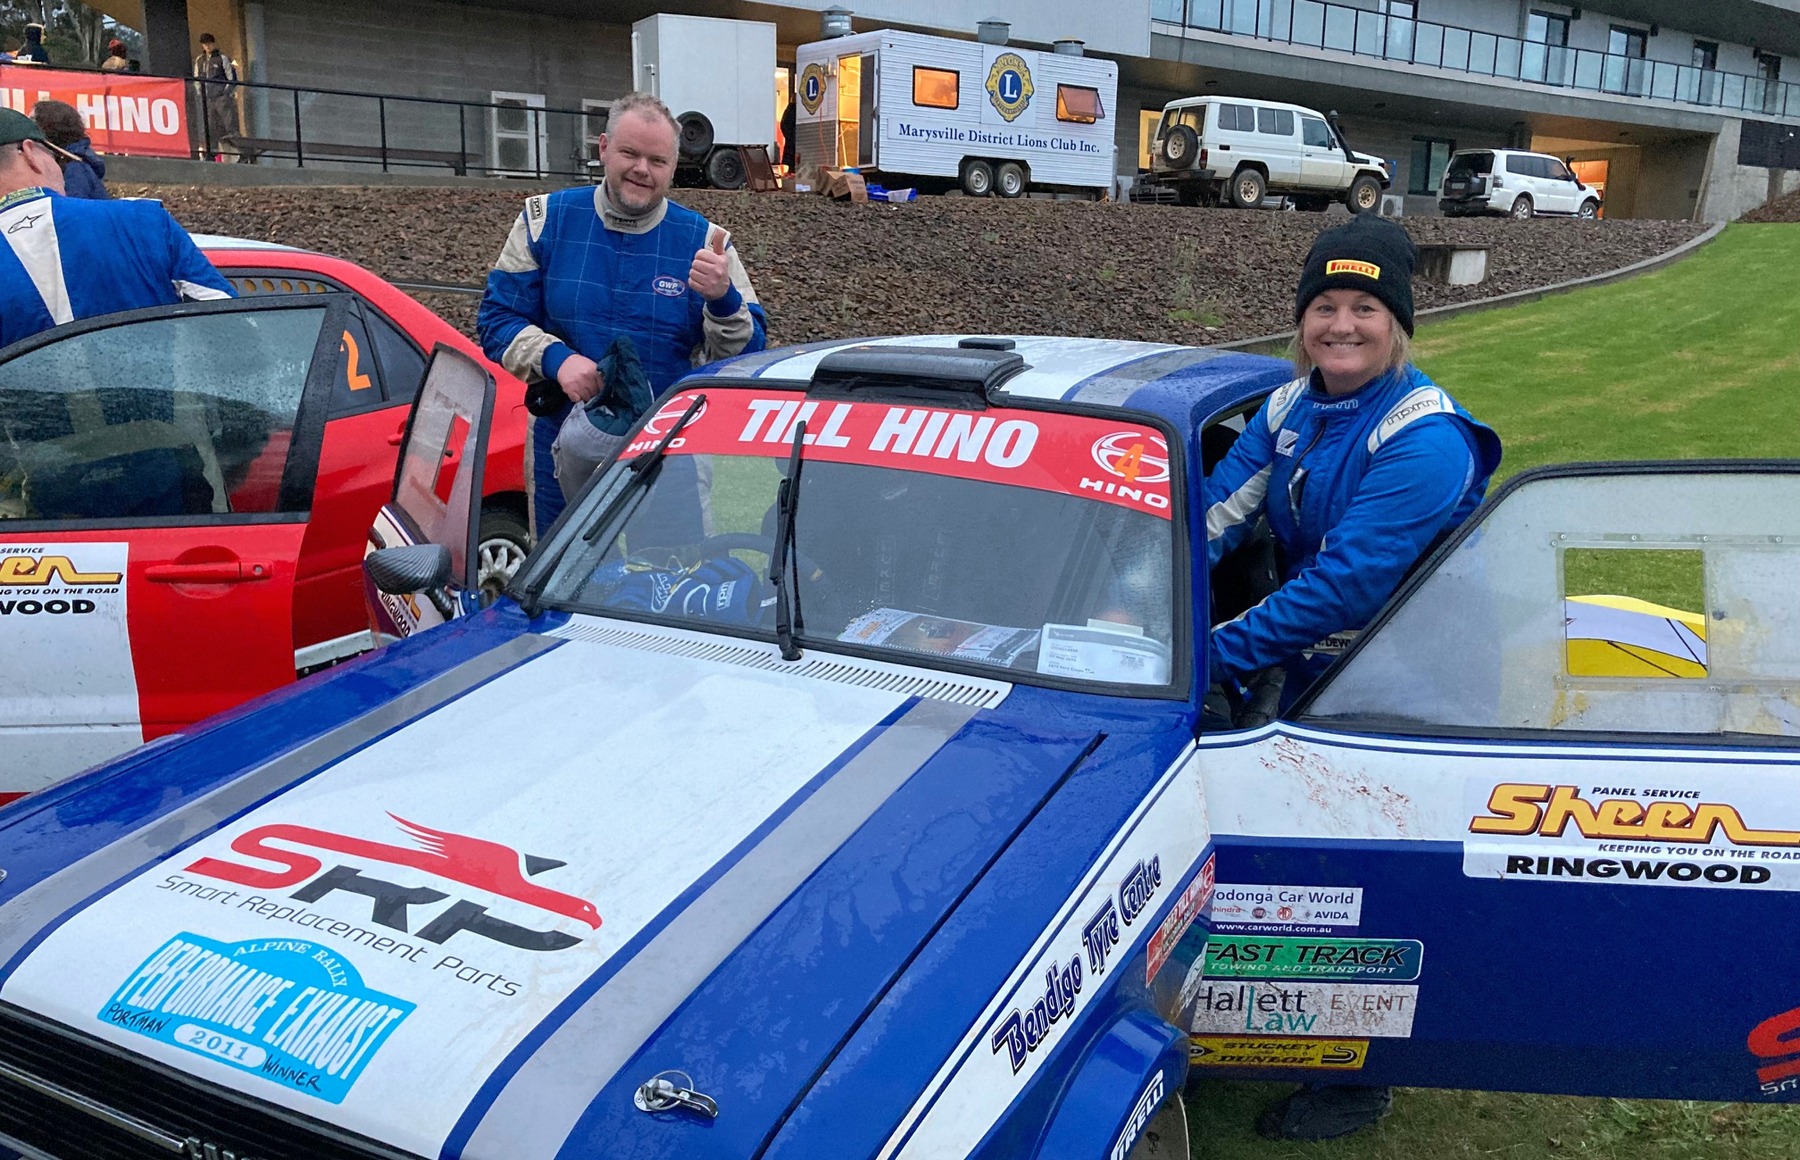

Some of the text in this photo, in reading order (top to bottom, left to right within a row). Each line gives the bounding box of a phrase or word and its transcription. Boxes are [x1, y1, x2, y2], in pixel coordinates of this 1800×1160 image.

[808, 79, 817, 97] L
[1003, 73, 1018, 98] L
[76, 93, 180, 136] HINO
[899, 123, 1101, 153] Marysville District Lions Club Inc.
[1330, 261, 1376, 276] PIRELLI
[659, 280, 678, 289] GWP
[737, 398, 1040, 469] TILL HINO
[1113, 443, 1145, 483] 4
[1078, 476, 1169, 509] HINO
[16, 588, 40, 596] YOU
[63, 587, 84, 595] THE
[1591, 786, 1701, 799] PANEL SERVICE
[1467, 782, 1800, 846] Sheen
[1597, 843, 1800, 860] KEEPING YOU ON THE ROAD
[1505, 854, 1772, 885] RINGWOOD
[1211, 889, 1273, 904] odonga
[1279, 890, 1304, 903] Car
[1308, 891, 1355, 905] World
[1216, 923, 1332, 934] www.carworld.com.au
[1314, 911, 1349, 920] AVIDA
[156, 875, 523, 998] Smart Replacement Parts
[233, 938, 348, 988] ALPINE RALLY
[991, 853, 1162, 1077] Bendigo Tyre Centre
[1211, 962, 1267, 972] TOWING
[1304, 964, 1397, 974] TRANSPORT
[1296, 945, 1412, 966] TRACK
[103, 1002, 171, 1034] PORTMAN
[115, 938, 404, 1080] PERFORMANCE EXHAUST
[189, 1029, 250, 1061] 2011
[1223, 1042, 1318, 1050] STUCKEY
[262, 1053, 322, 1093] WINNER
